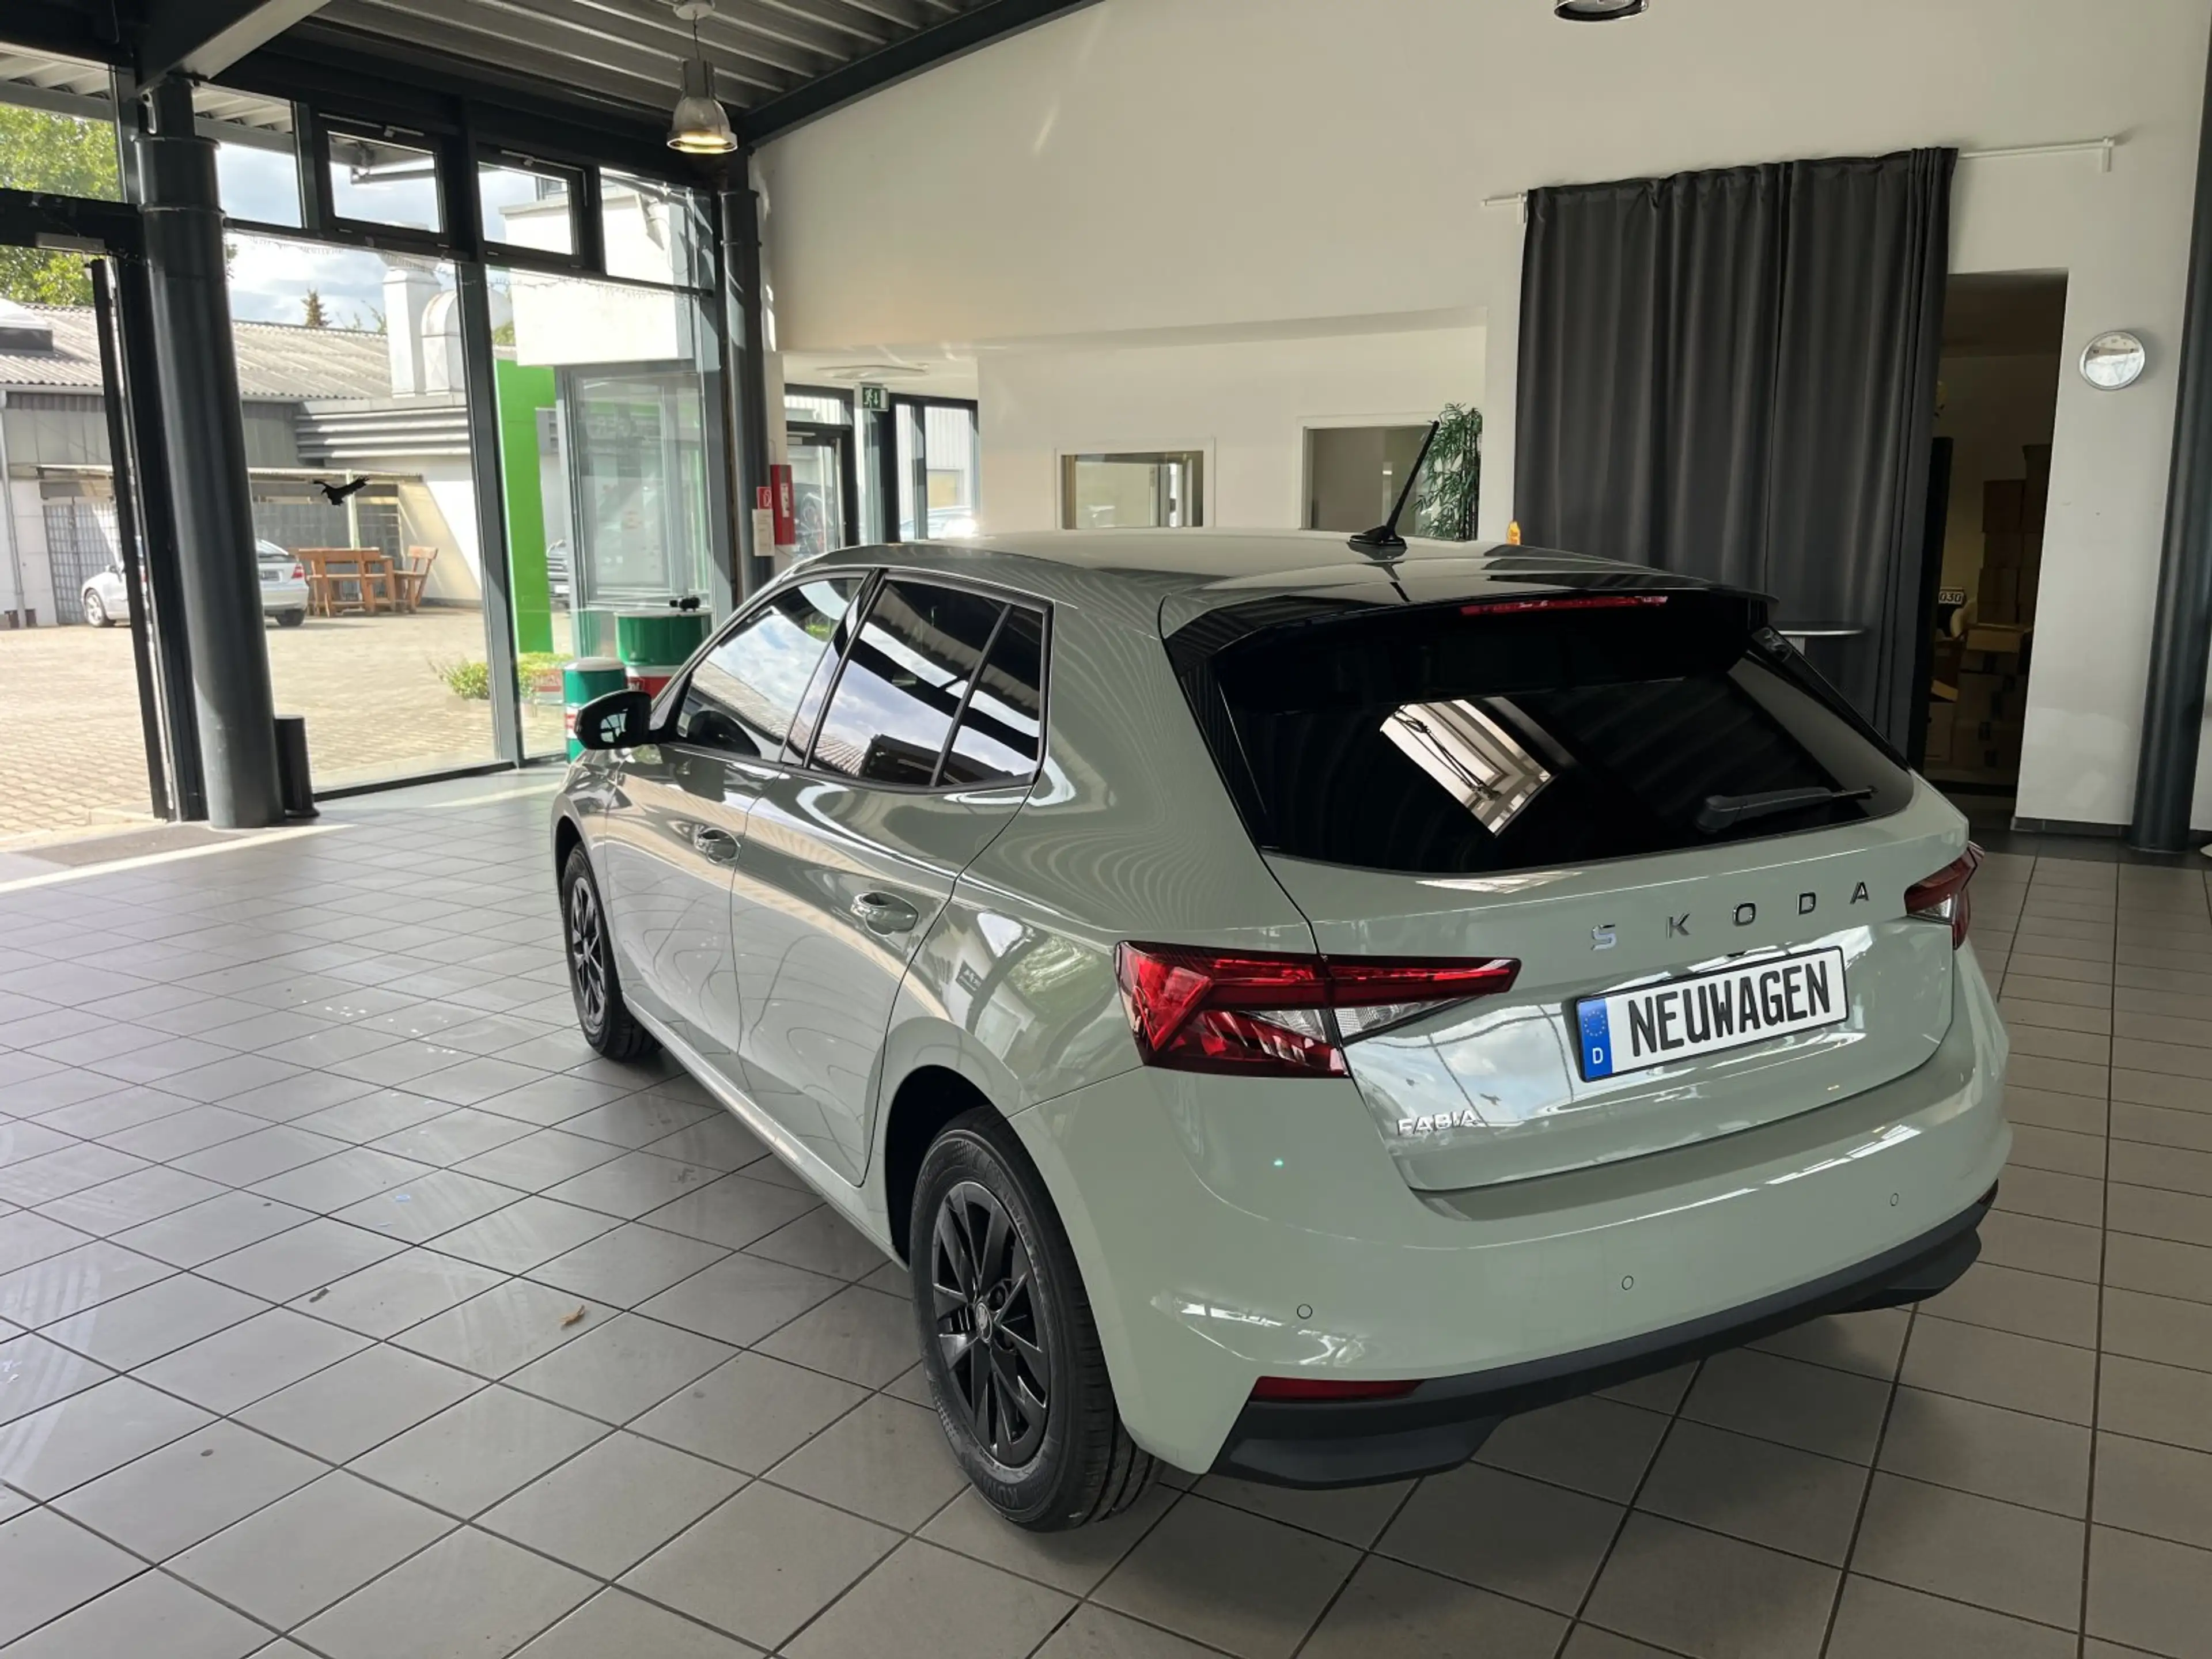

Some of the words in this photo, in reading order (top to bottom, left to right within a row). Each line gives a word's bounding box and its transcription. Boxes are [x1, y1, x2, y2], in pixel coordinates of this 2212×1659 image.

[1591, 881, 1869, 950] SKODA
[1628, 960, 1830, 1057] NEUWAGEN
[1592, 1047, 1604, 1065] D
[1397, 1109, 1480, 1135] FABIA
